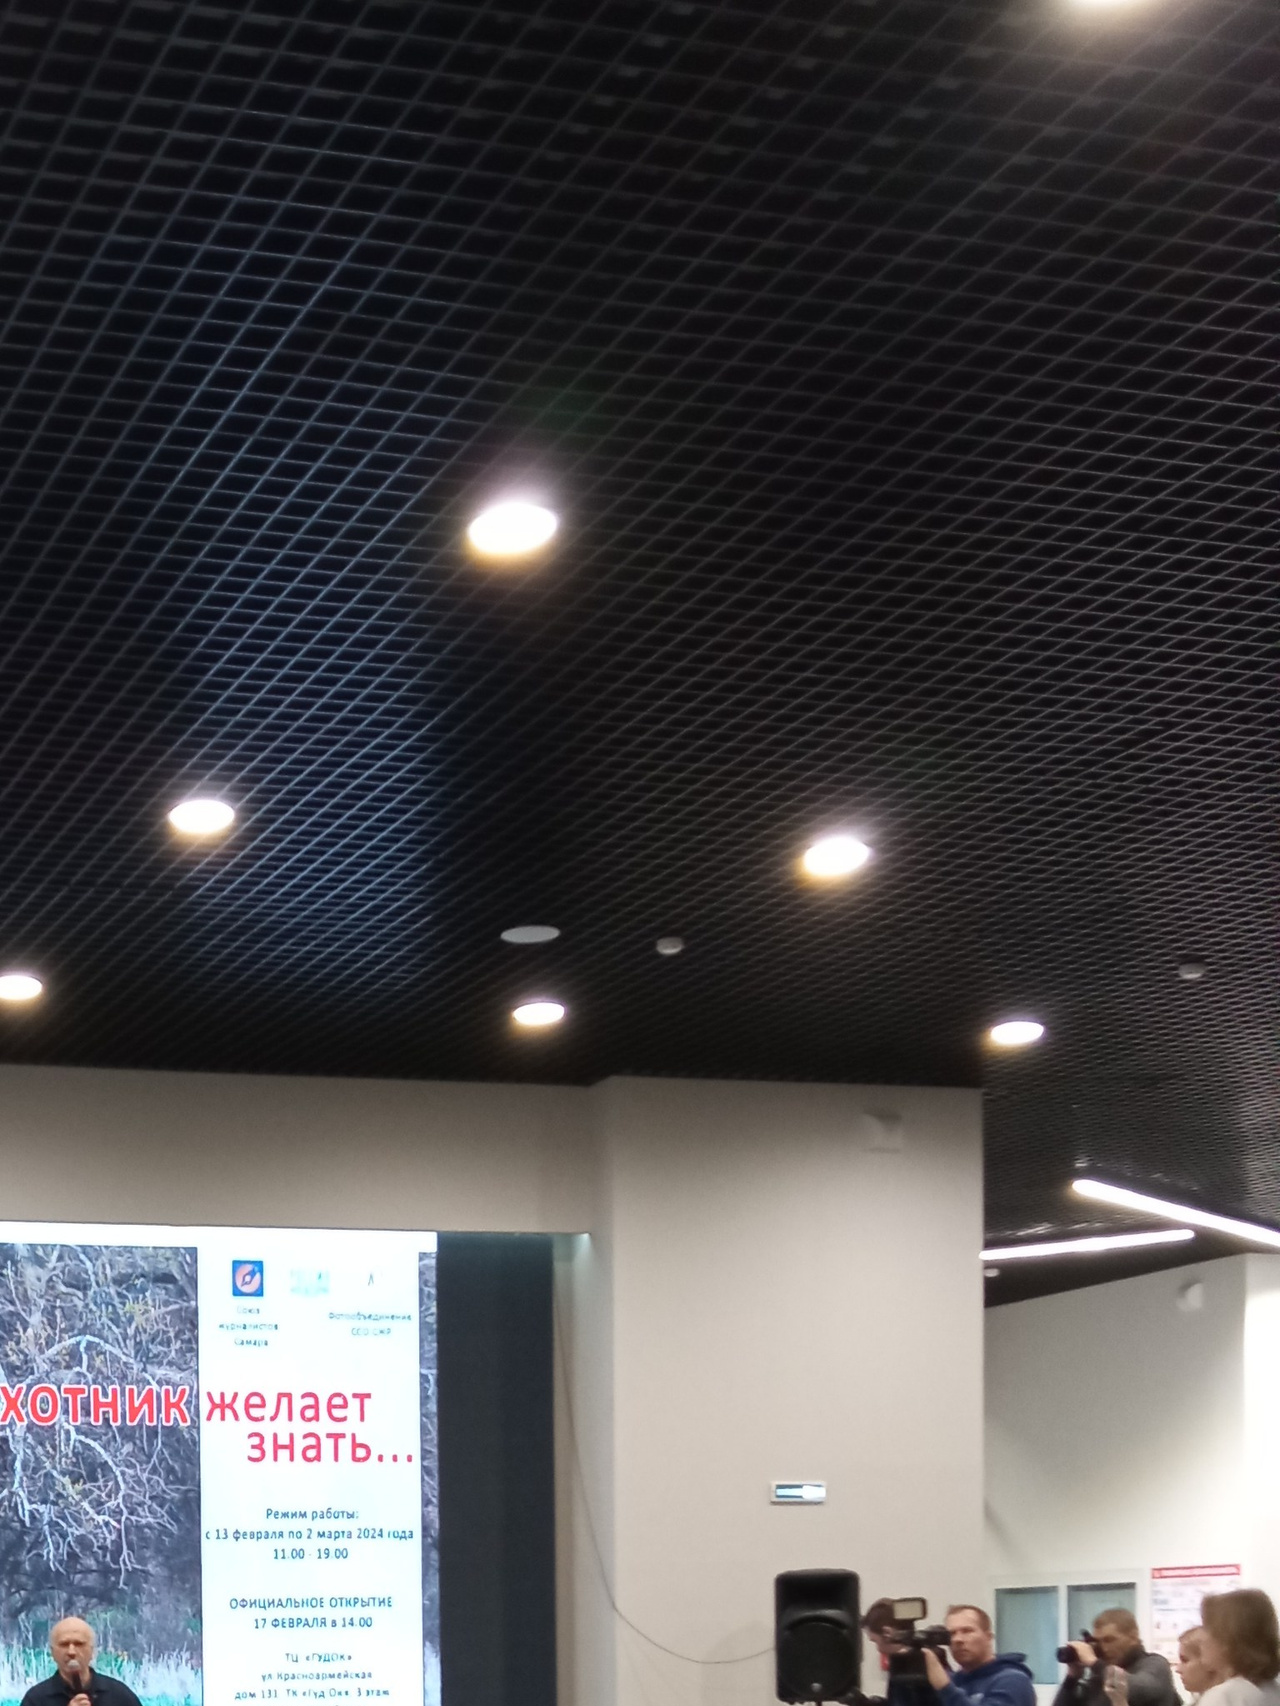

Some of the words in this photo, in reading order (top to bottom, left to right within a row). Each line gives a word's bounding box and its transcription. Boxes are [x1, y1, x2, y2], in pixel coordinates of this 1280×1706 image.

[234, 1337, 268, 1347] Самара
[205, 1388, 371, 1424] желает
[246, 1430, 414, 1464] знать...
[266, 1508, 307, 1520] Режим
[311, 1508, 359, 1521] работы:
[205, 1531, 211, 1540] с
[215, 1528, 228, 1539] 13
[233, 1528, 284, 1542] февраля
[288, 1530, 302, 1540] по
[306, 1528, 313, 1540] 2
[317, 1530, 353, 1542] марта
[356, 1528, 384, 1539] 2024
[387, 1530, 414, 1541] года
[273, 1548, 305, 1560] 11.00
[317, 1548, 349, 1559] 19.00
[229, 1597, 325, 1610] ОФИЦИАЛЬНОЕ
[329, 1596, 393, 1608] ОТКРЫТИЕ
[254, 1618, 267, 1629] 17
[271, 1617, 327, 1629] ФЕВРАЛЯ
[331, 1620, 337, 1628] в
[341, 1616, 373, 1628] 14.00
[277, 1670, 372, 1681] Красноармейская
[234, 1690, 256, 1700] дом
[357, 1687, 362, 1697] 3
